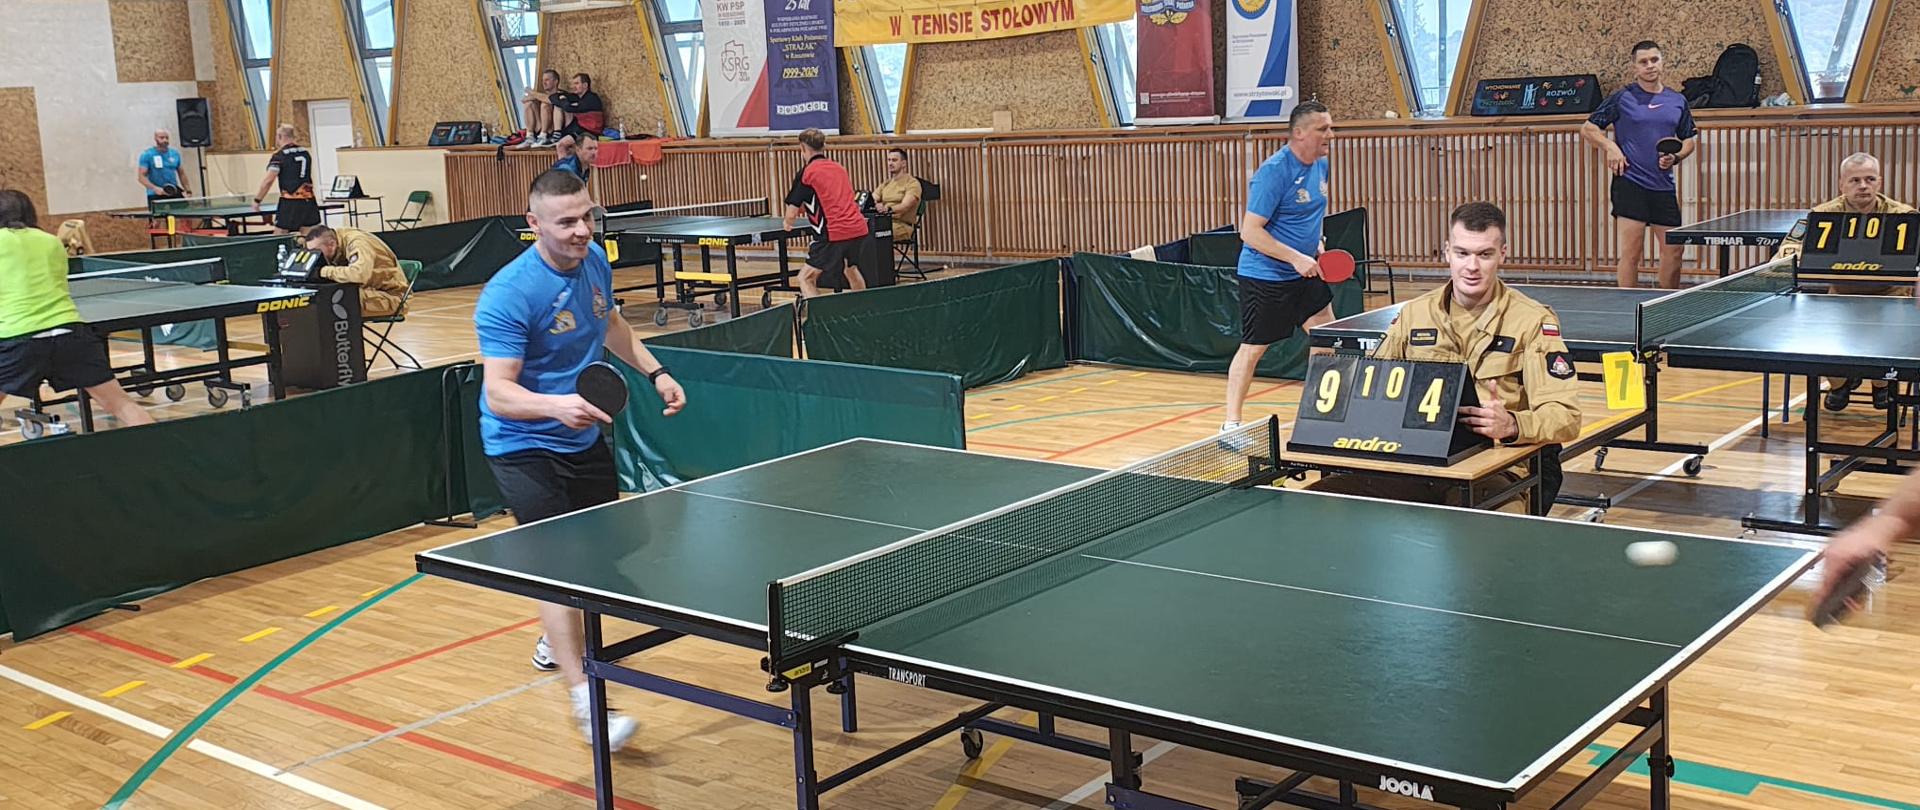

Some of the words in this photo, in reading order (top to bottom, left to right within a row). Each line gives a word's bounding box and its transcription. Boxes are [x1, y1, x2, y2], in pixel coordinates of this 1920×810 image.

[730, 1, 745, 11] PSP
[889, 15, 901, 37] W
[911, 11, 973, 36] TENISIE
[980, 0, 1075, 33] STOŁOWYM
[721, 56, 749, 72] KSRG
[783, 66, 820, 78] 1999-2024
[1546, 89, 1576, 97] ROZWÓJ
[294, 156, 307, 178] 7
[698, 237, 729, 246] DONIC
[1704, 236, 1744, 246] TIBHAR
[1816, 221, 1833, 249] 7
[1847, 217, 1858, 238] 1
[1865, 217, 1880, 239] 0
[1896, 223, 1908, 251] 1
[1830, 261, 1883, 272] andro
[256, 296, 311, 313] DONIC
[334, 320, 353, 386] Butterfly
[1614, 359, 1630, 401] 7
[1315, 369, 1341, 413] 9
[1361, 365, 1376, 397] 1
[1385, 366, 1406, 399] 0
[1418, 378, 1444, 423] 4
[1332, 436, 1401, 453] andro
[888, 666, 927, 688] TRANSPORT
[1379, 775, 1434, 801] JOOLA
